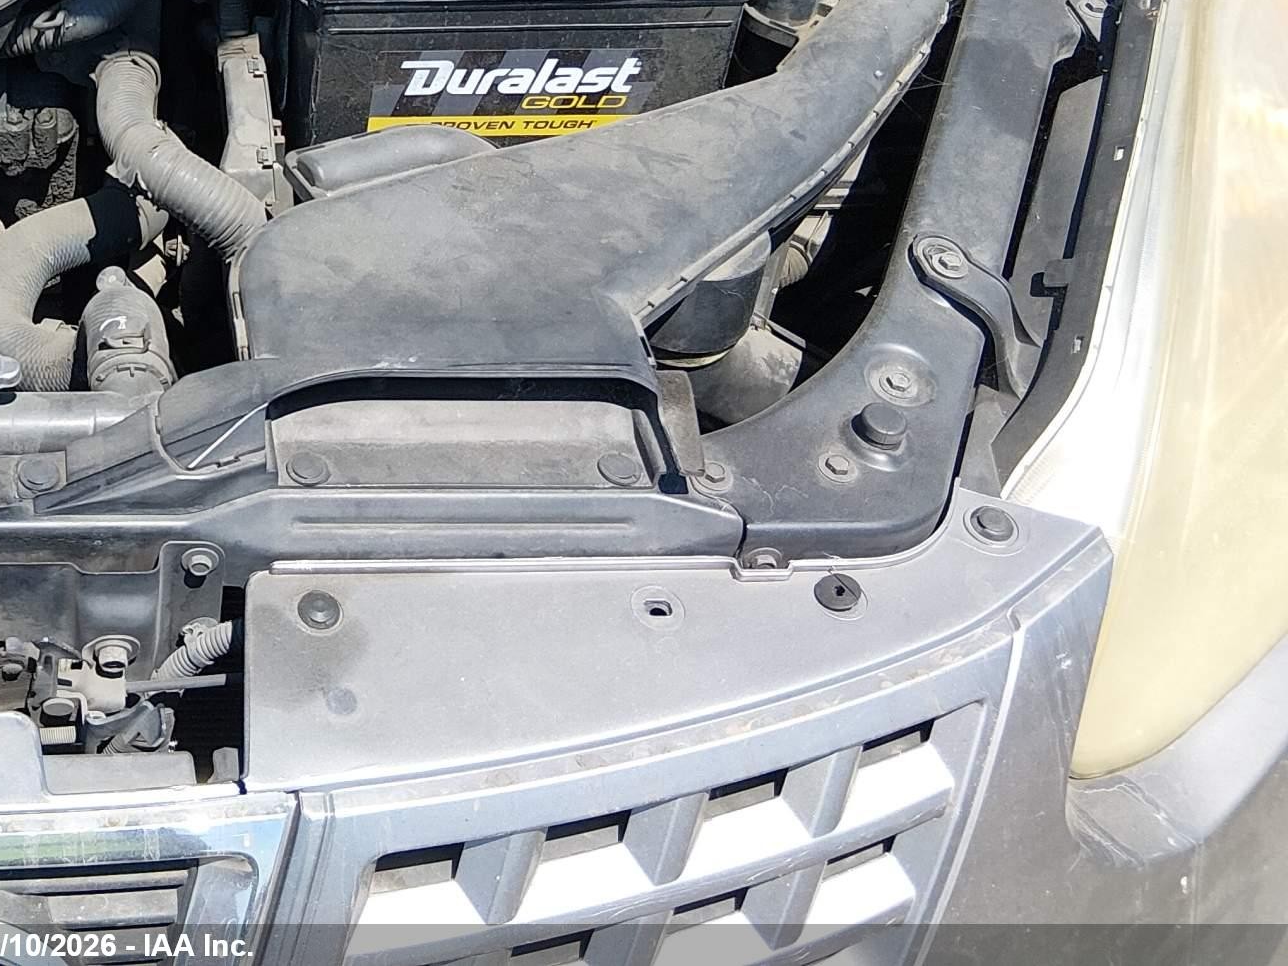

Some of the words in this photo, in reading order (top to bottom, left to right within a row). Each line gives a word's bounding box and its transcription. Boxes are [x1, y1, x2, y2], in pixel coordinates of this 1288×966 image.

[401, 58, 641, 97] Duralast
[521, 95, 627, 110] GOLD
[523, 120, 593, 130] TOUGH
